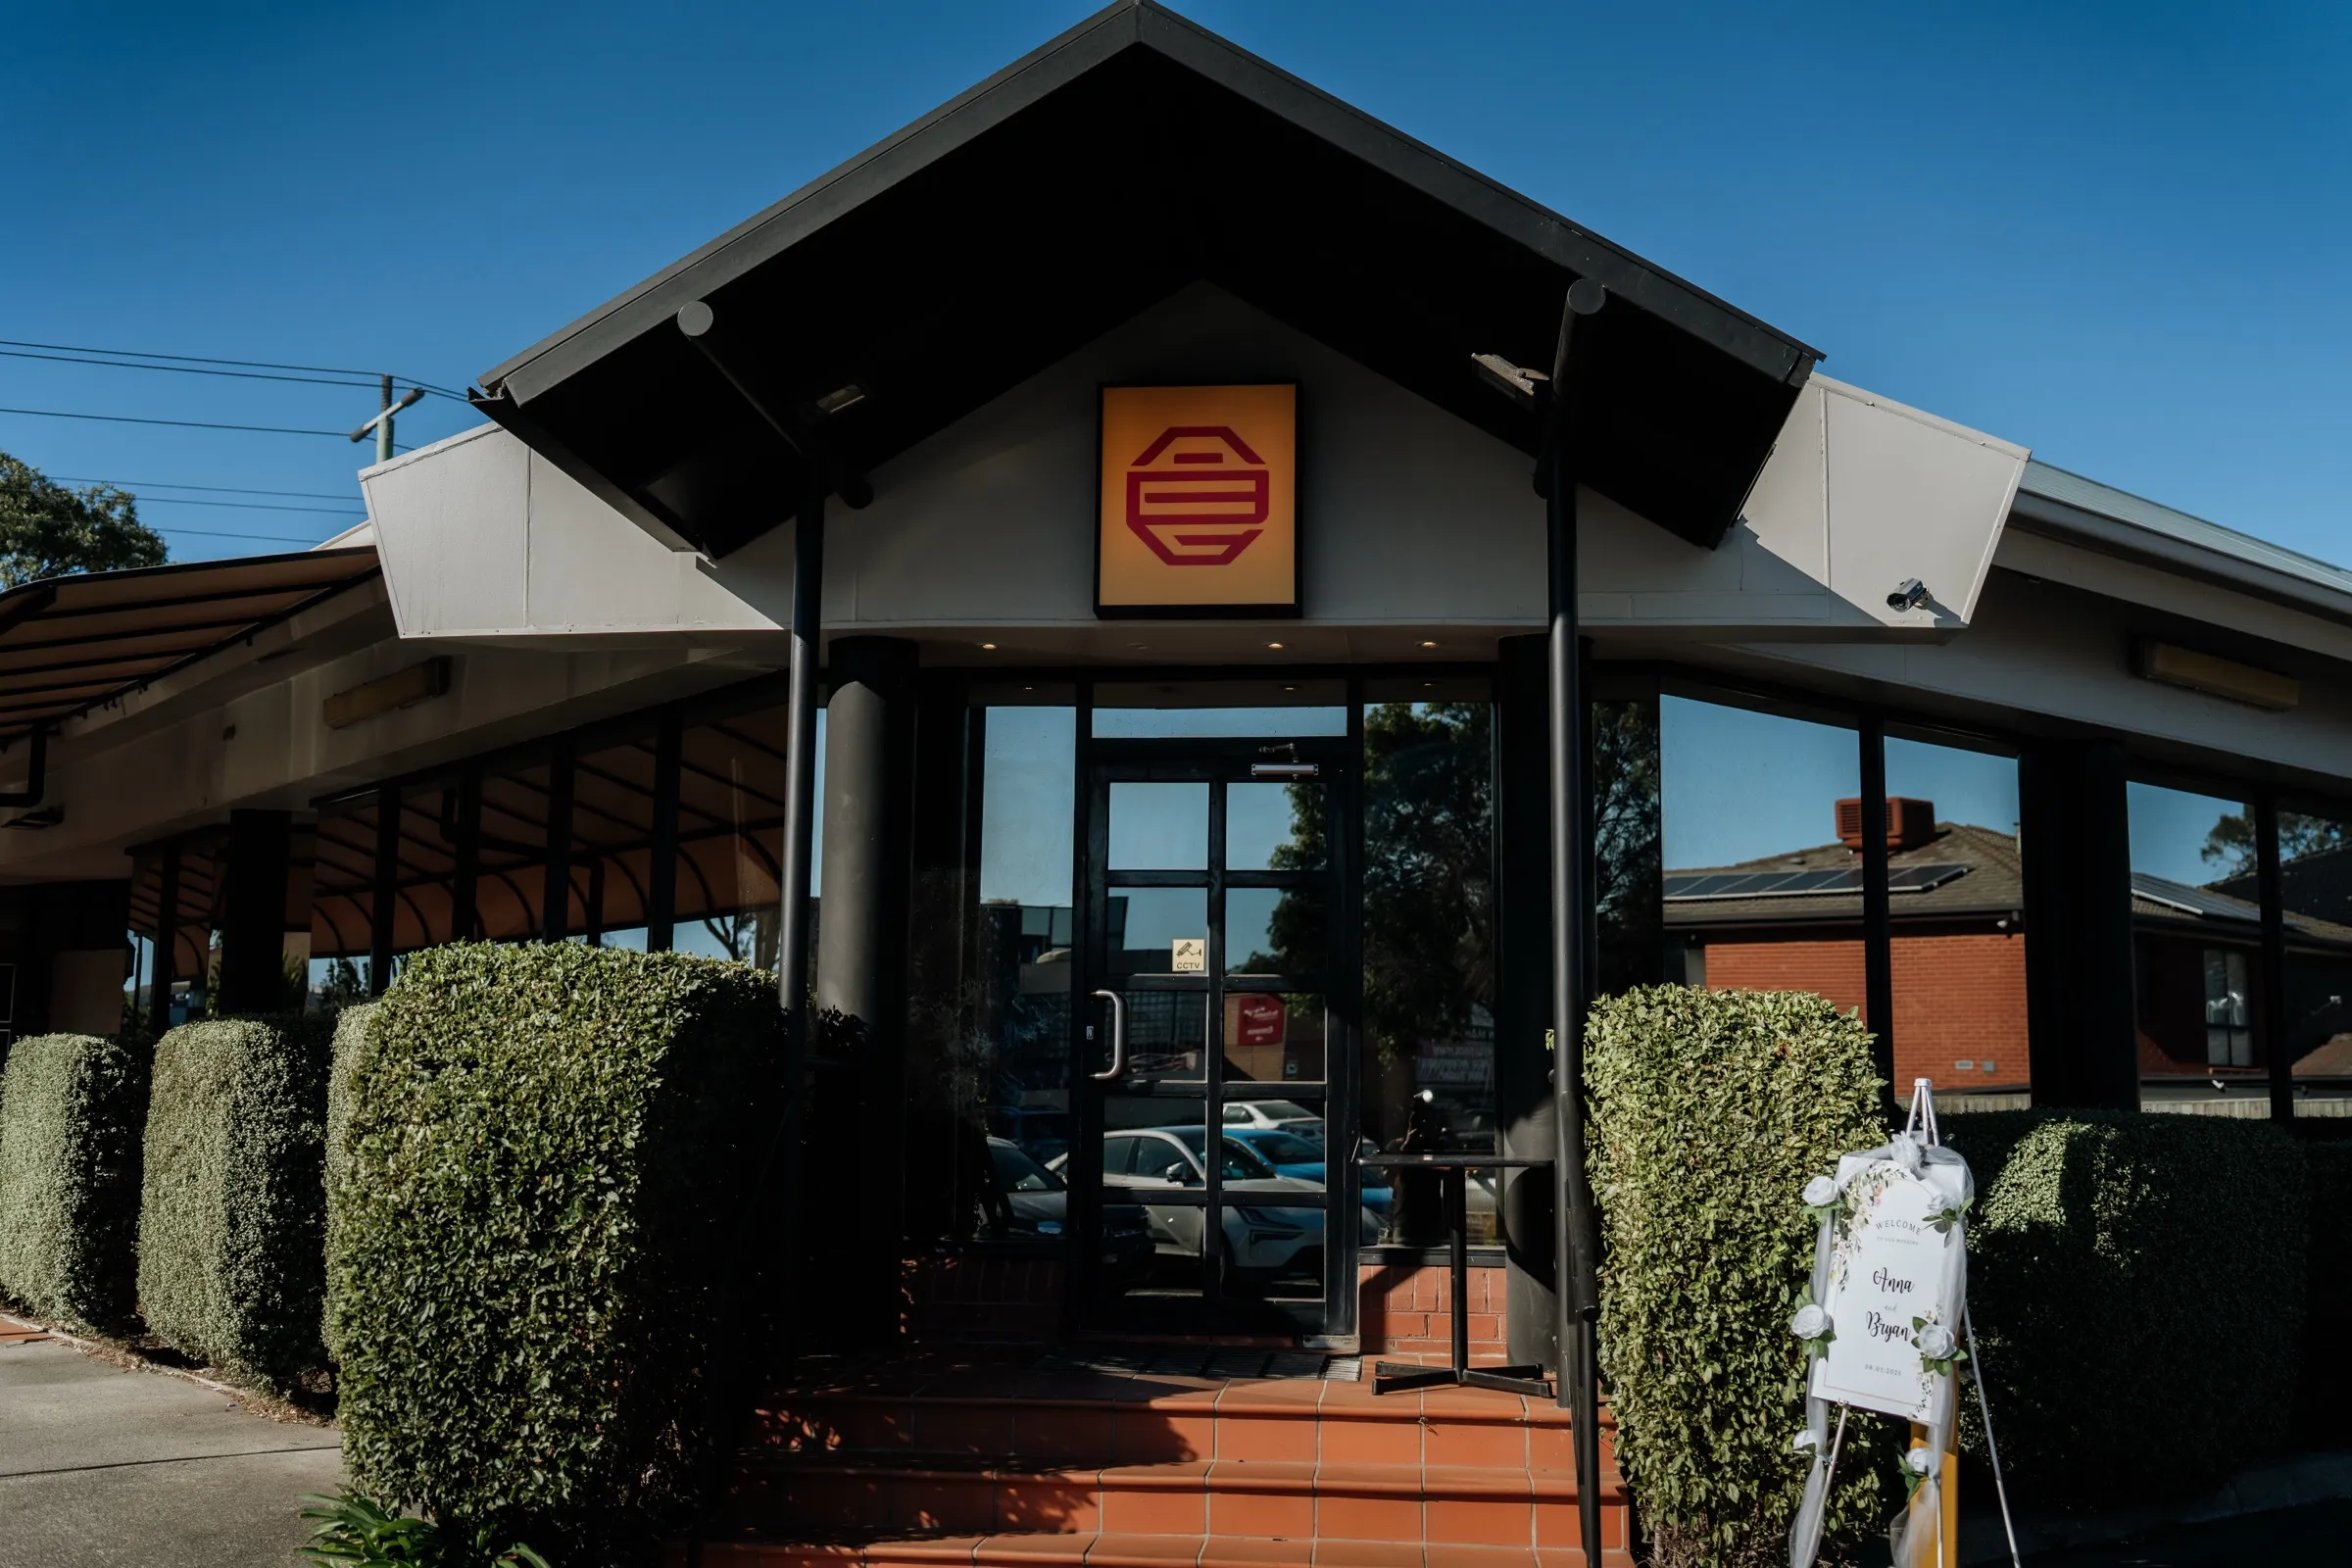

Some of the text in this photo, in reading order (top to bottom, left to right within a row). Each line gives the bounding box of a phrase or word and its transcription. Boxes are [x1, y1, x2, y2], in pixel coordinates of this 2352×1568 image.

[1875, 1219, 1922, 1236] WELCOME
[1873, 1266, 1915, 1294] Anna
[1866, 1310, 1911, 1343] Bryan
